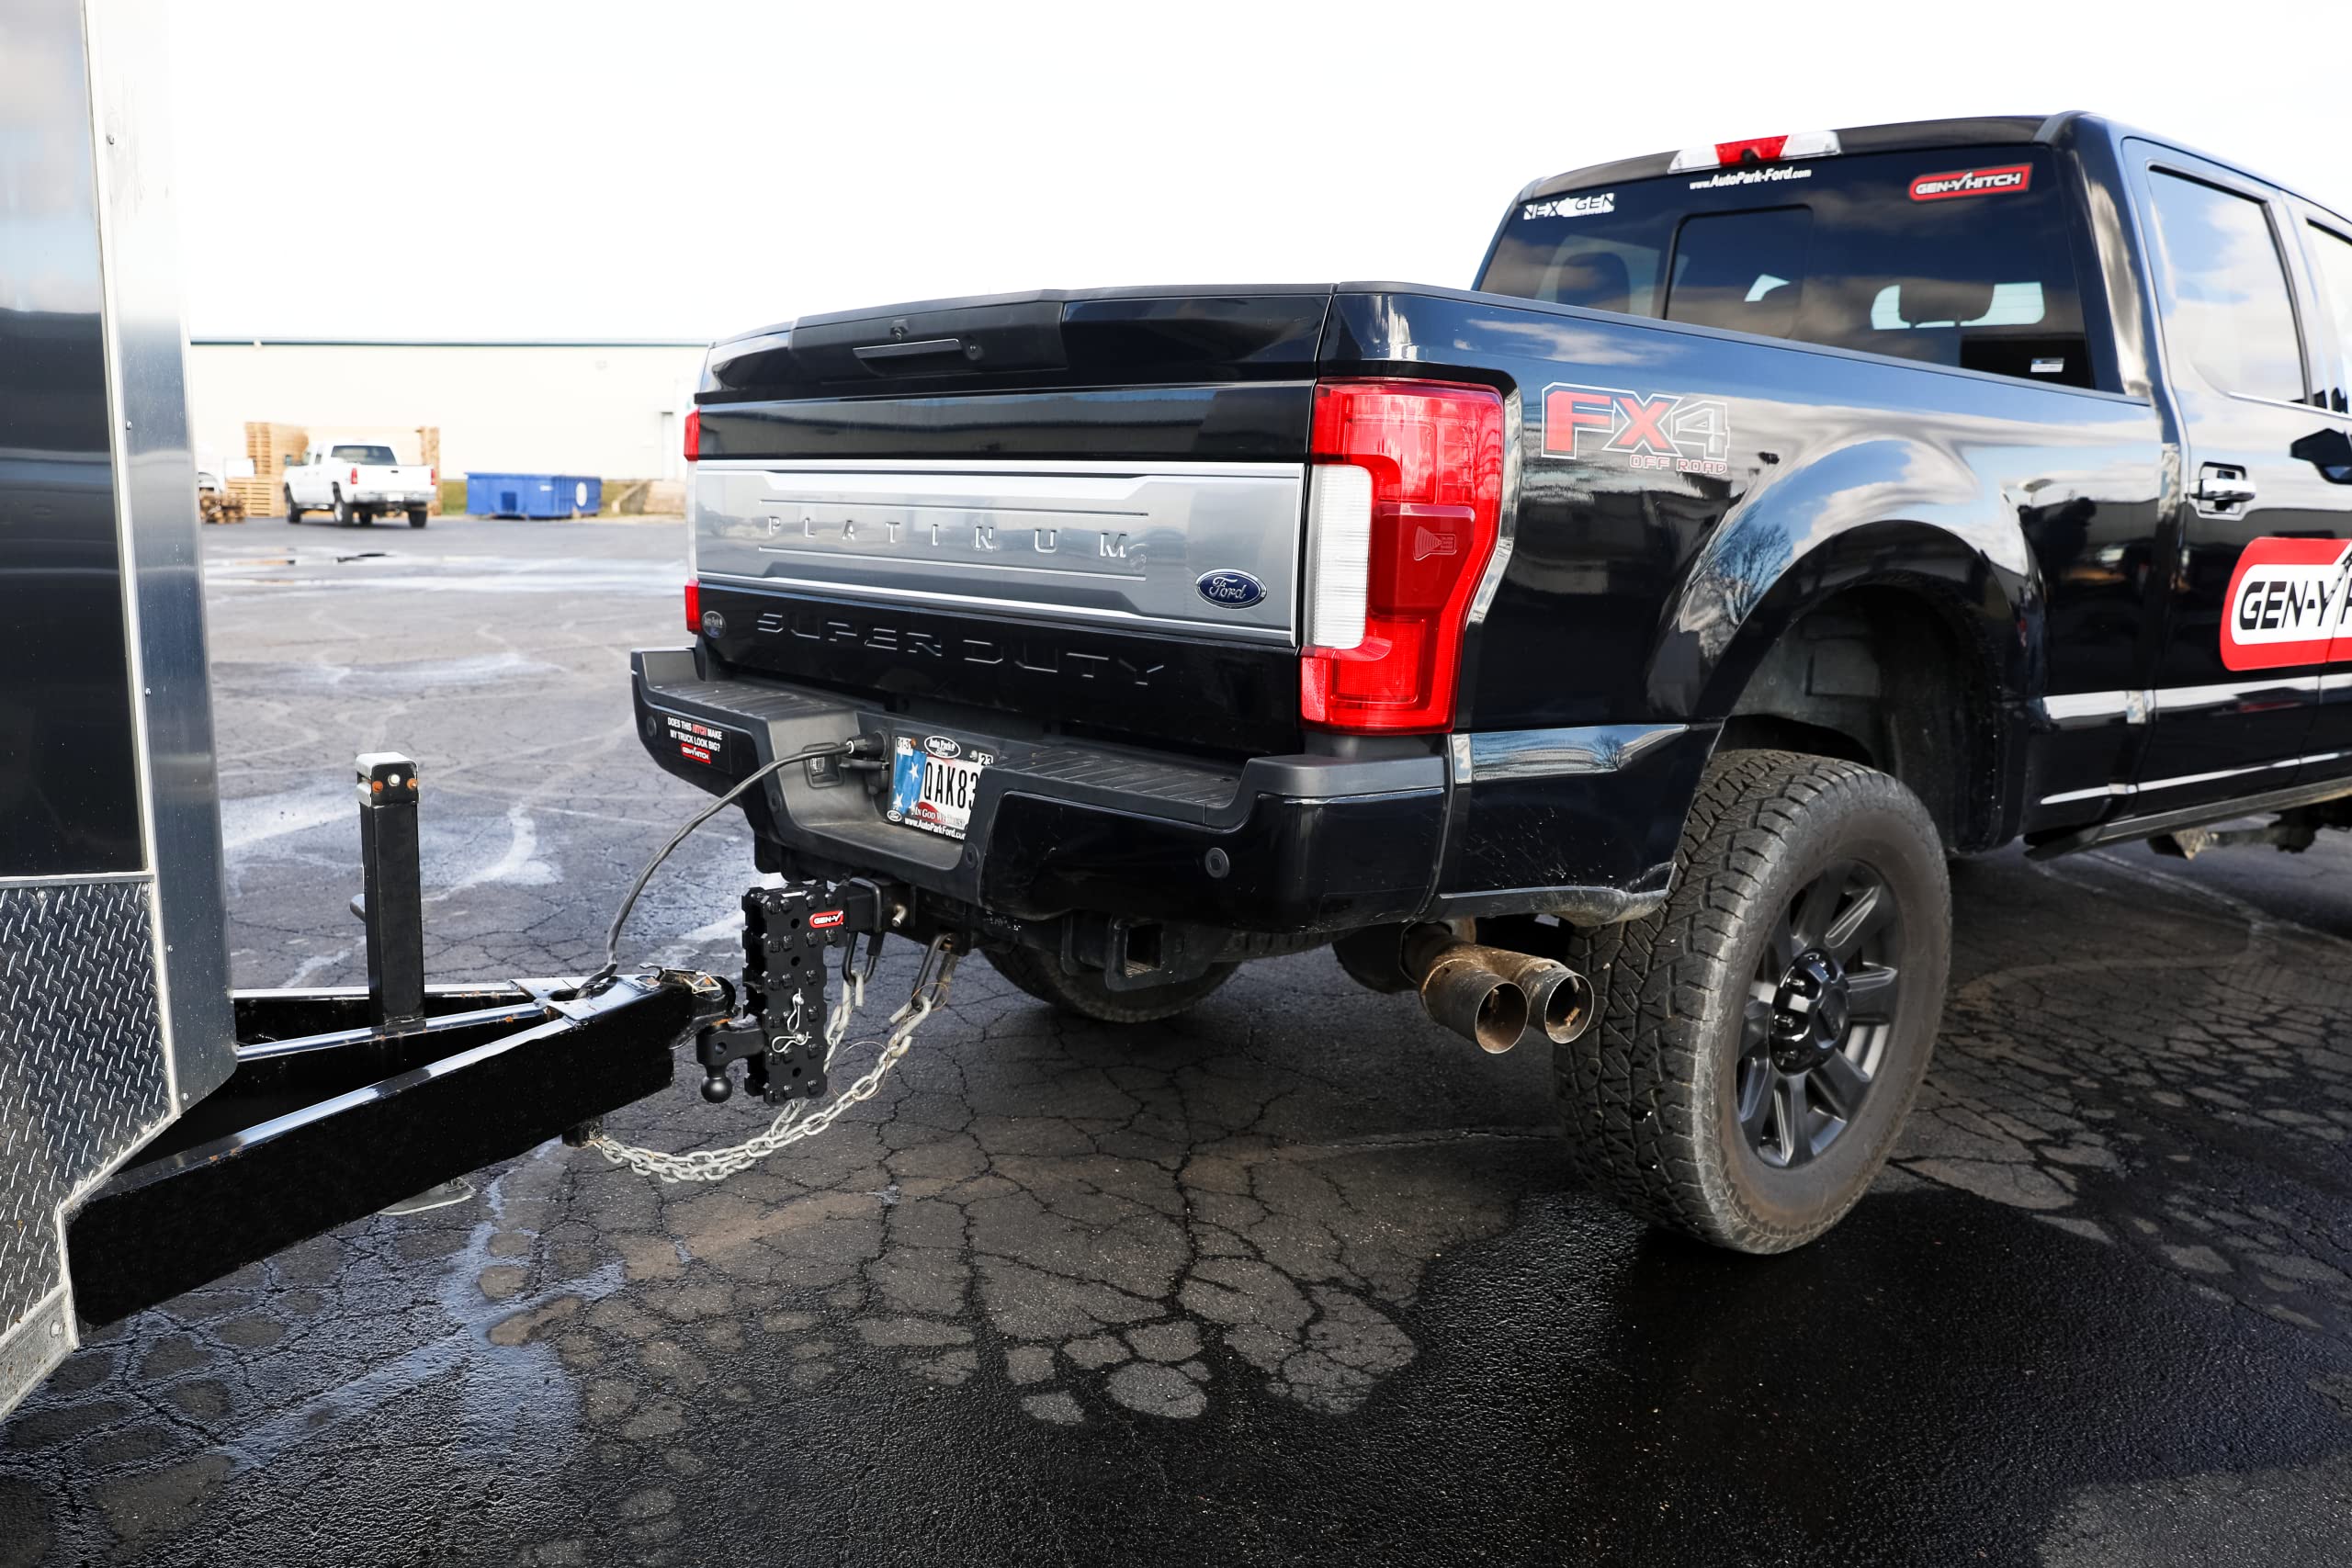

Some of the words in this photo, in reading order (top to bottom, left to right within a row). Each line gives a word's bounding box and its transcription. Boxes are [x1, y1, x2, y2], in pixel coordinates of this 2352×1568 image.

[1690, 165, 1812, 190] www.AutoPark-Ford.com
[1541, 382, 1730, 462] FX4
[1630, 454, 1669, 470] OFF
[1676, 458, 1727, 475] ROAD
[767, 514, 1128, 558] PLATINUM
[1209, 576, 1247, 599] Ford
[757, 613, 943, 657] SUPER
[962, 639, 1165, 686] DUTY
[668, 717, 680, 728] DOES
[681, 721, 692, 732] THIS
[707, 728, 722, 740] MAKE
[670, 729, 677, 739] MY
[678, 732, 694, 743] TRUCK
[694, 738, 707, 748] LOOK
[708, 741, 721, 752] BIG?
[980, 755, 992, 767] 23
